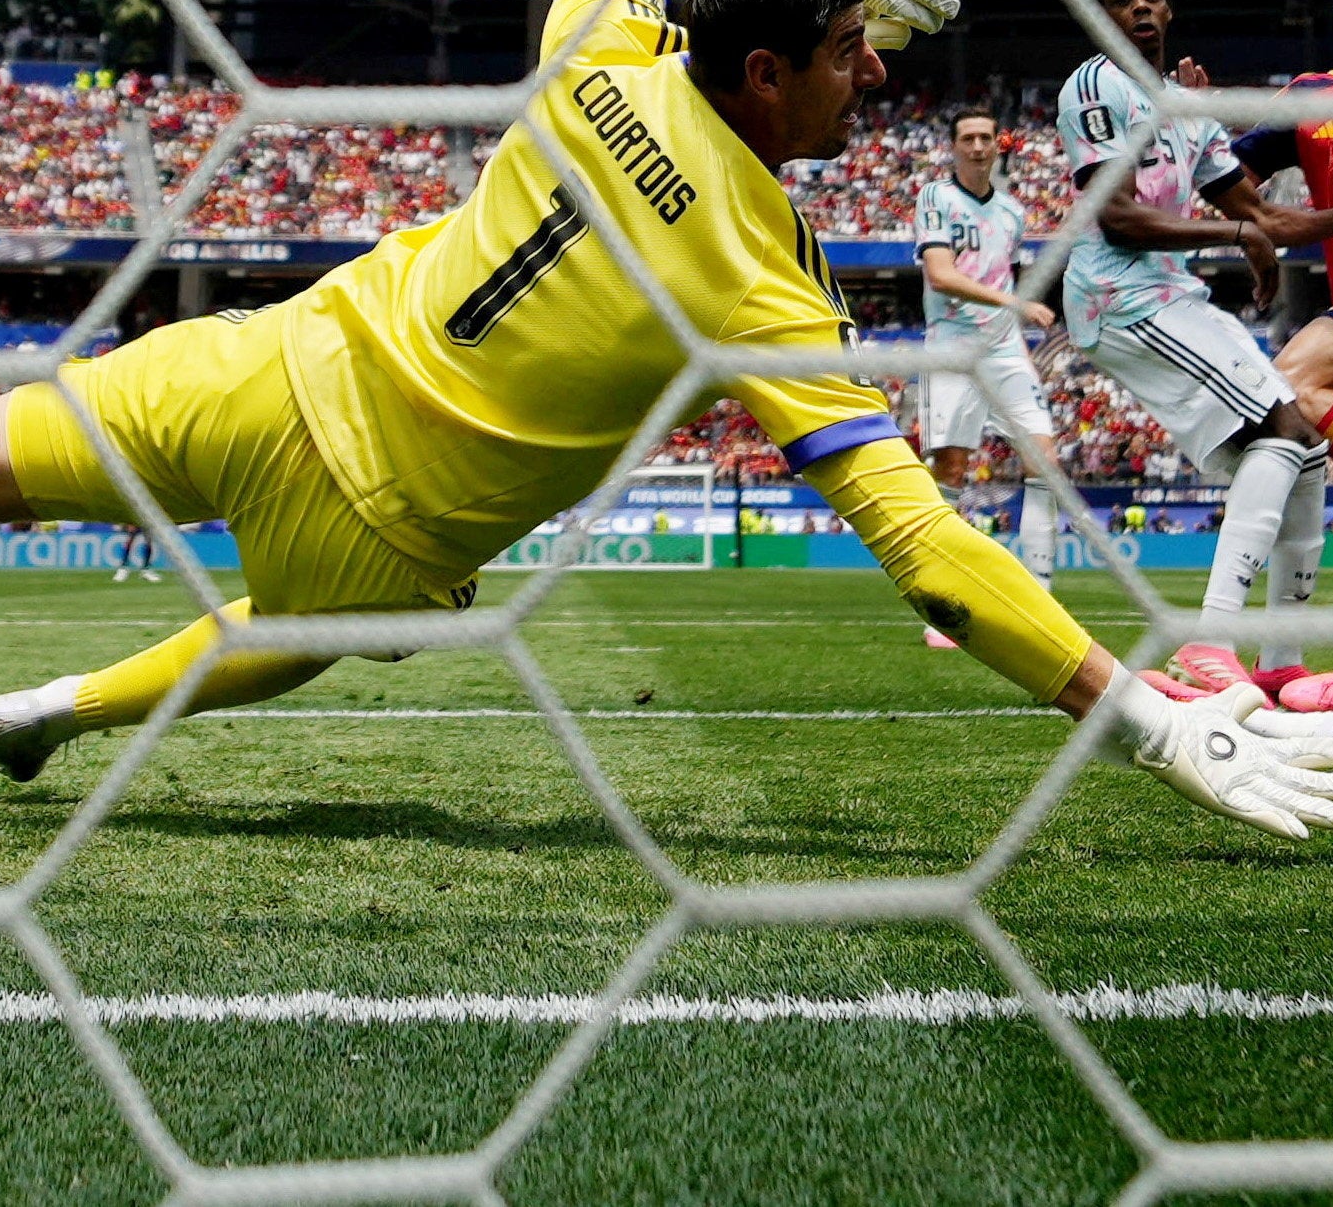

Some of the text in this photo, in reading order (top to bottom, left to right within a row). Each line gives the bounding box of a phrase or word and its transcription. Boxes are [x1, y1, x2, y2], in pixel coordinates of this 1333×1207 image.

[572, 69, 697, 225] COURTOIS
[444, 182, 590, 348] 1
[951, 222, 981, 252] 20
